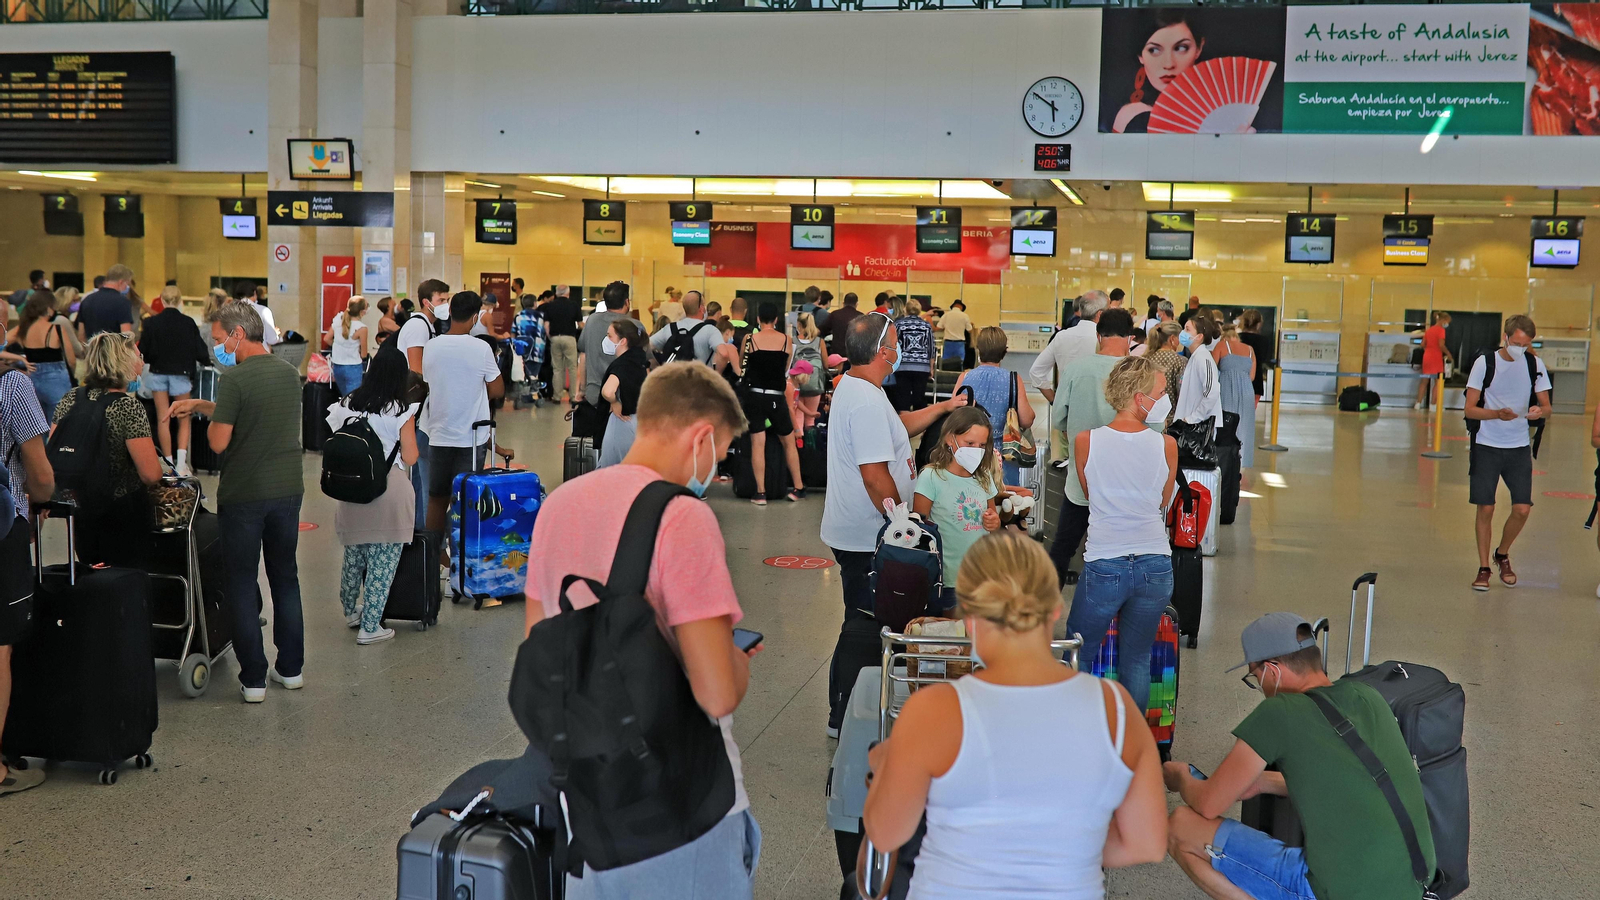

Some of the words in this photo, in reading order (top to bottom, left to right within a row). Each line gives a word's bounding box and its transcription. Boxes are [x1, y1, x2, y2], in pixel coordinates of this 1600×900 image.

[1304, 23, 1322, 41] A
[1327, 22, 1382, 40] taste
[1388, 23, 1407, 41] of
[1413, 21, 1510, 41] Andalusia
[1295, 49, 1311, 62] at
[1314, 49, 1338, 62] the
[1341, 49, 1398, 66] airport...
[1403, 49, 1441, 62] start
[1445, 49, 1472, 62] with
[1477, 45, 1518, 62] Jerez
[1070, 92, 1075, 100] 2
[1298, 92, 1346, 104] Saborea
[1350, 92, 1406, 104] Andalucía
[1409, 96, 1422, 104] en
[1426, 93, 1436, 104] el
[1439, 93, 1509, 108] aeropuerto...
[1347, 107, 1392, 120] empieza
[1395, 109, 1412, 120] por
[1037, 146, 1058, 156] 25.0
[57, 196, 66, 210] 2
[118, 197, 127, 211] 3
[233, 200, 243, 213] 4
[491, 202, 501, 216] 7
[312, 211, 343, 221] Llegadas
[600, 204, 610, 217] 8
[686, 204, 696, 219] 9
[803, 208, 822, 222] 10
[929, 210, 948, 224] 11
[1024, 211, 1044, 225] 12
[1161, 215, 1181, 229] 13
[1300, 218, 1321, 232] 14
[963, 230, 993, 238] BERIA
[1397, 220, 1418, 234] 15
[1545, 221, 1568, 236] 16
[864, 256, 916, 266] Facturación
[326, 265, 336, 273] IB
[864, 267, 901, 277] Check-in
